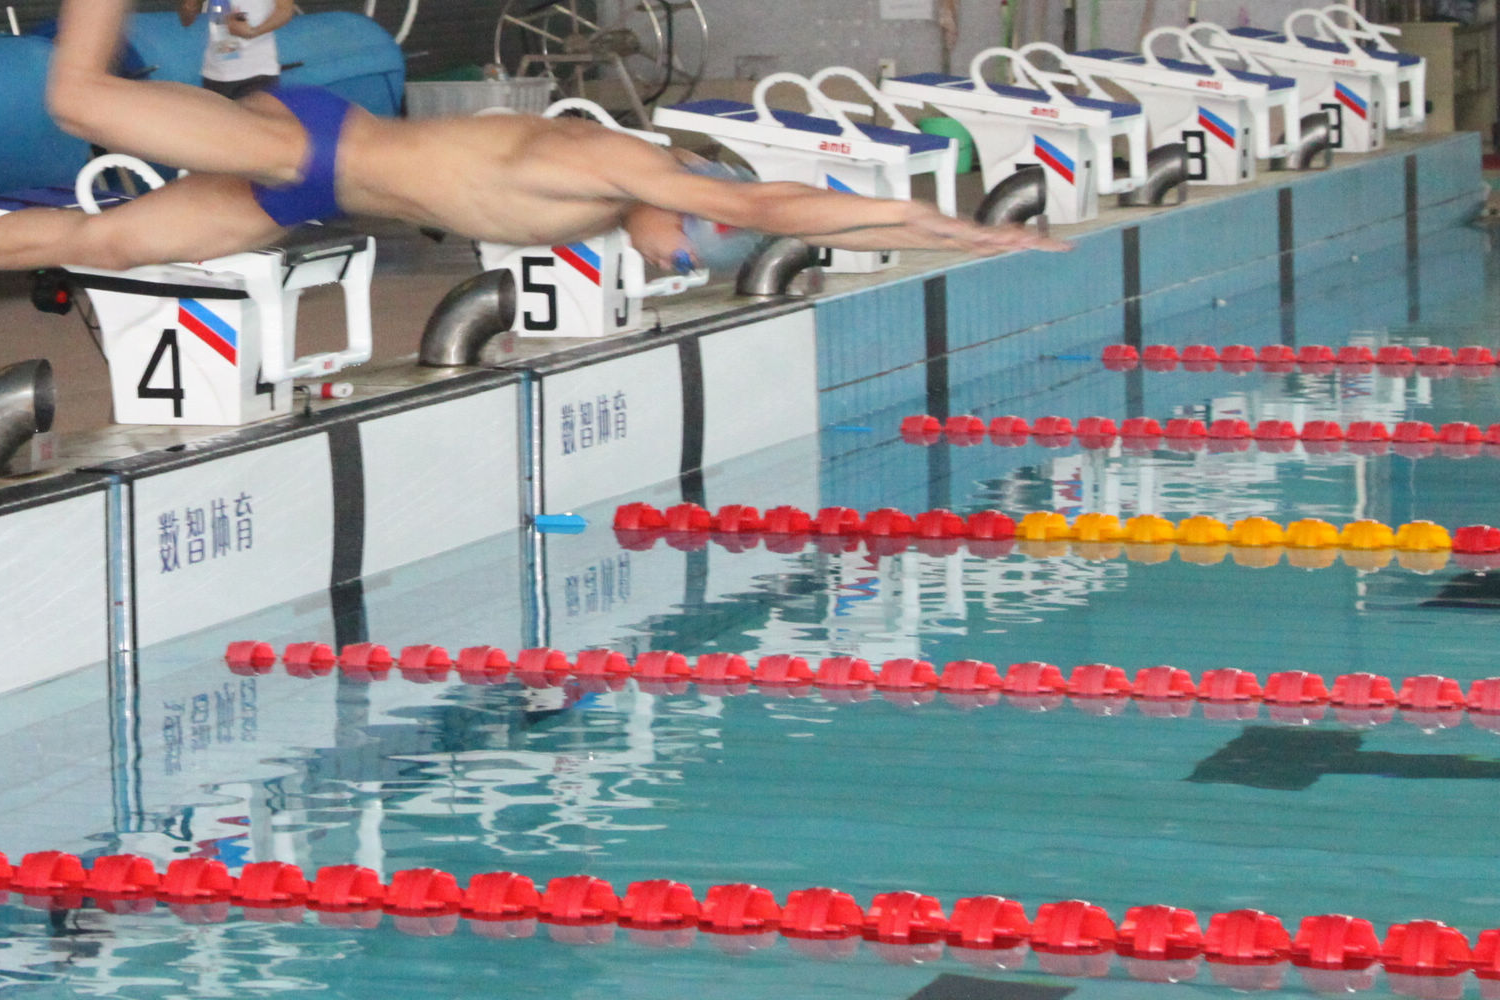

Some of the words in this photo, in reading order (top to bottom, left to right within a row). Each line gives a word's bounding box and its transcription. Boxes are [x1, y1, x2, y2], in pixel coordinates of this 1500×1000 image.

[817, 140, 851, 155] anti
[521, 256, 558, 331] 5
[138, 328, 184, 418] 4
[561, 389, 629, 457] 数智体育
[157, 491, 253, 574] 数智体育
